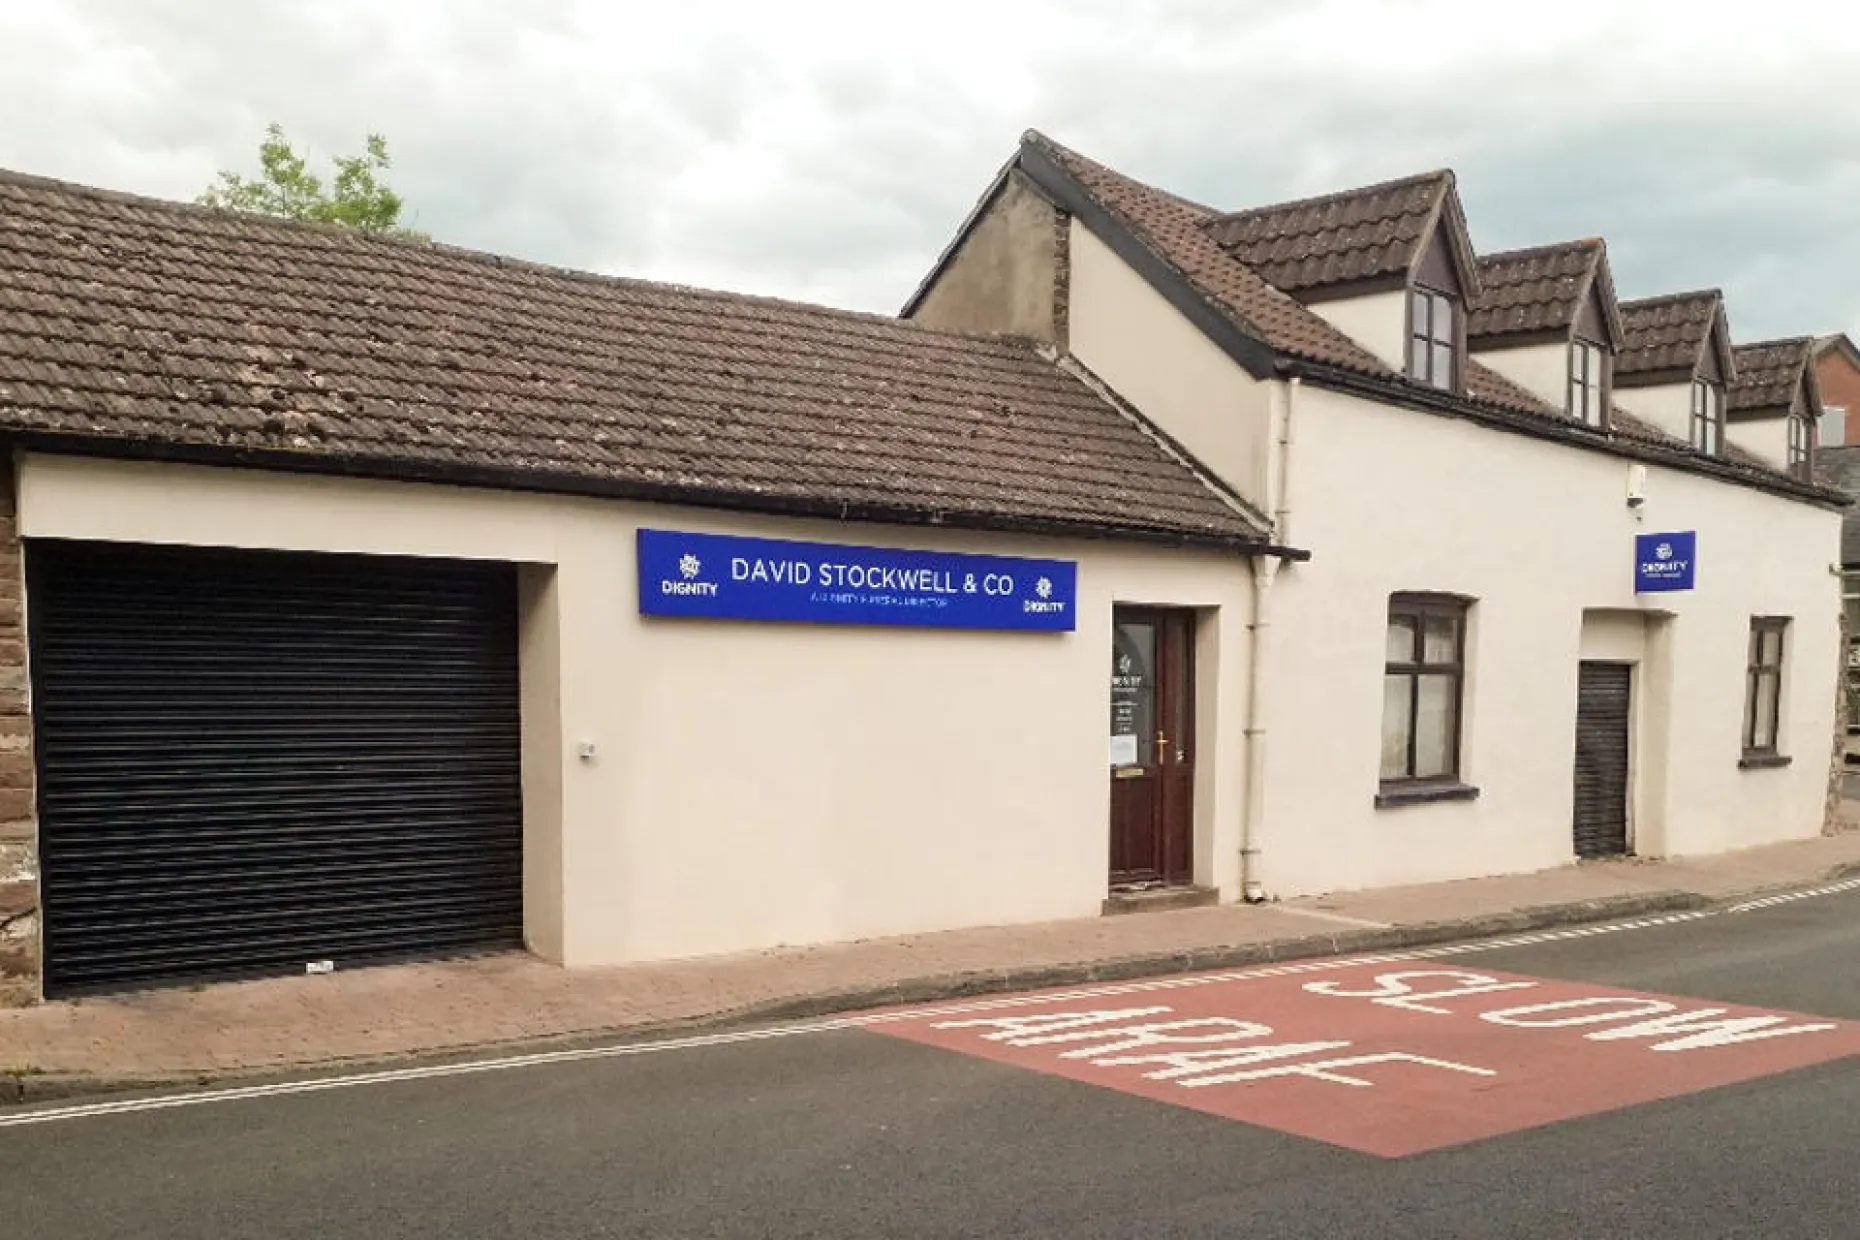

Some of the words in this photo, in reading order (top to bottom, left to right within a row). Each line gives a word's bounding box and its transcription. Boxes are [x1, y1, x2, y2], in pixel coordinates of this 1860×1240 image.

[661, 579, 719, 597] DIGNITY
[731, 557, 811, 584] DAVID
[819, 563, 958, 593] STOCKWELL
[963, 573, 978, 593] &
[983, 573, 1015, 595] CO
[1022, 600, 1066, 613] DIGNITY
[1302, 970, 1837, 1051] SLOW
[930, 1006, 1497, 1087] ARAF
